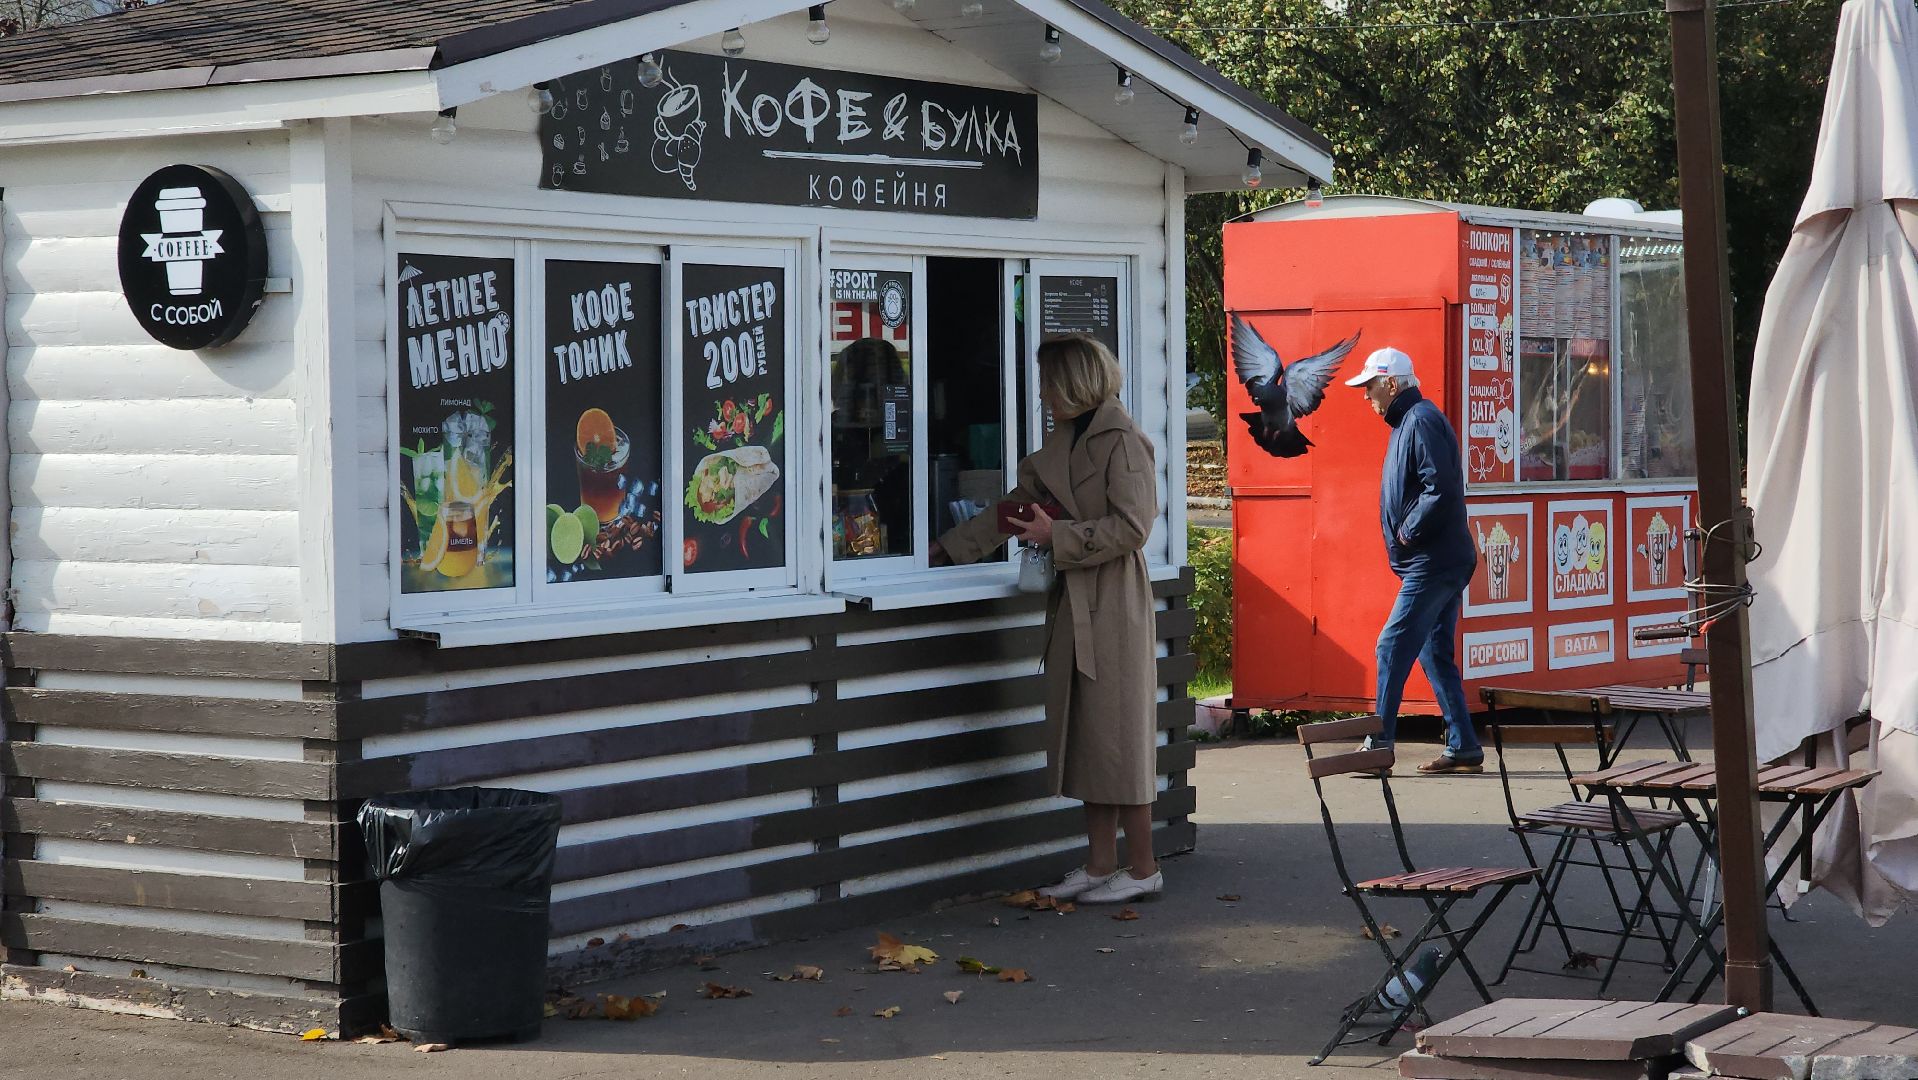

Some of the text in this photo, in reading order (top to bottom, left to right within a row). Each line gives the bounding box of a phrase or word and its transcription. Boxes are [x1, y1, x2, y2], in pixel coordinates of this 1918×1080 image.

[883, 92, 907, 141] &
[921, 100, 1022, 166] БУЛКА
[809, 170, 948, 208] КОФЕЙНЯ
[158, 239, 210, 258] COFFEE
[1470, 230, 1510, 253] ПОПКОРН
[407, 270, 500, 329] ЛЕТНЕЕ
[571, 281, 635, 333] КОФЕ
[836, 289, 878, 300] IS IN THE AIR
[151, 298, 223, 325] С СОБОЙ
[685, 280, 776, 338] ТВИСТЕР
[1470, 302, 1497, 315] БОЛЬШОЙ
[407, 318, 510, 390] МЕНЮ
[553, 329, 633, 385] ТОНИК
[703, 331, 756, 390] 200
[752, 325, 768, 376] РУБЛЕЙ
[440, 399, 471, 407] ЛИМОНАД
[1470, 385, 1498, 398] СЛАДКАЯ
[1471, 400, 1496, 421] ВАТА
[412, 426, 439, 434] МОХИТО
[450, 537, 473, 546] ШМЕЛЬ
[1555, 571, 1606, 595] СЛАДКАЯ
[1470, 639, 1526, 665] POP CORN
[1564, 635, 1598, 654] ВАТА
